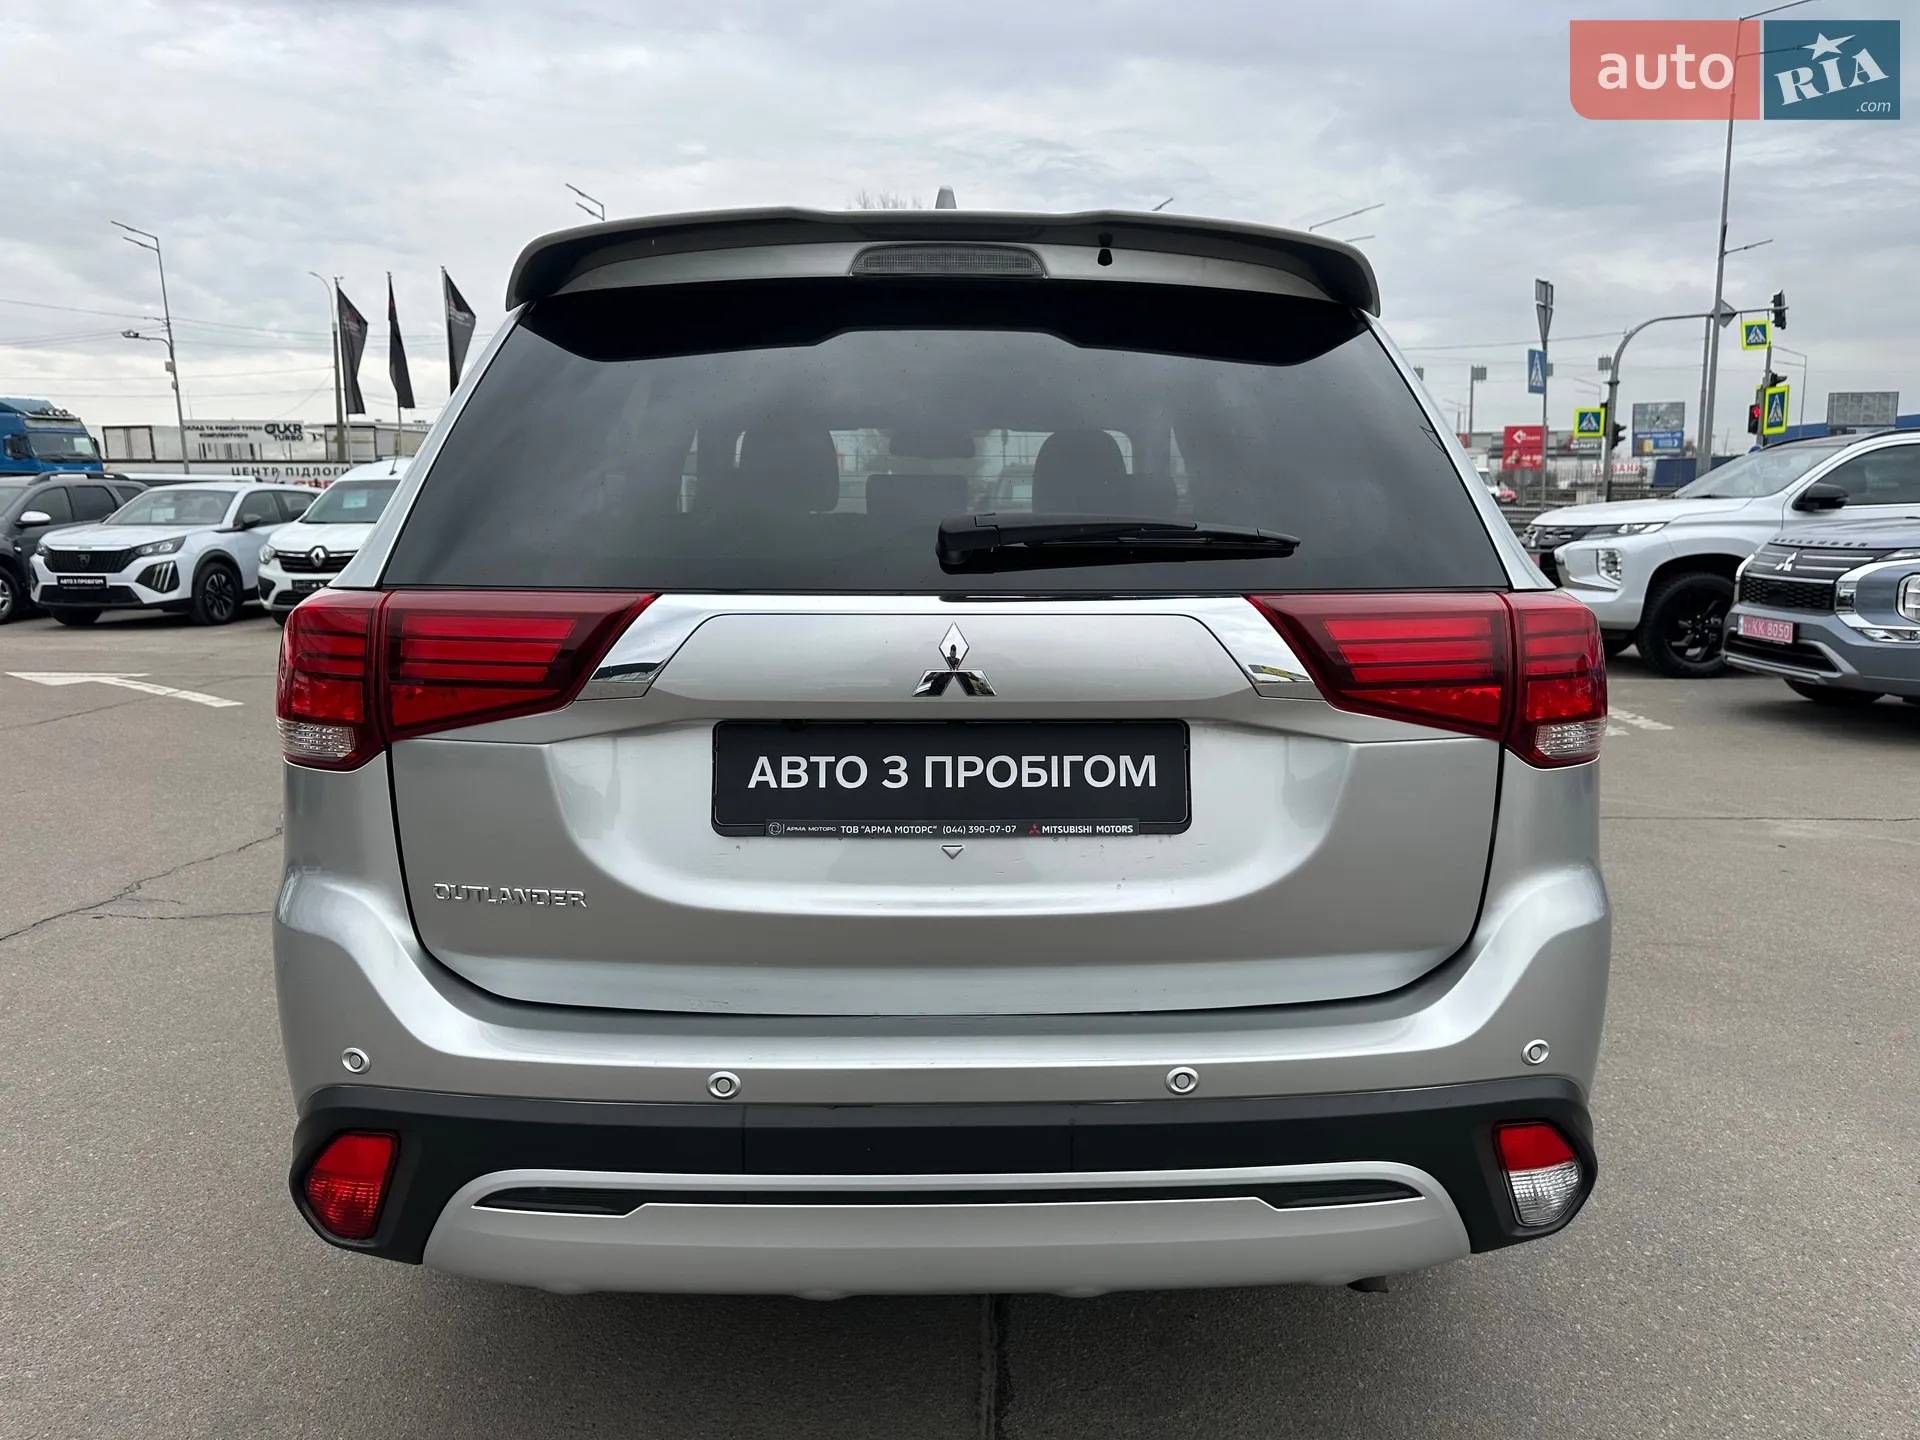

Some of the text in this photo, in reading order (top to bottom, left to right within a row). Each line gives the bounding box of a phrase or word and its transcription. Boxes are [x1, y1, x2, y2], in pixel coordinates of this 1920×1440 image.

[231, 467, 279, 476] ЦЕНТР
[1767, 622, 1790, 639] 8050
[747, 754, 1157, 790] АВТО З ПРОБІГОМ
[840, 825, 859, 834] ТОВ
[942, 825, 966, 835] (044)
[968, 825, 1017, 834] 390-07-07
[1042, 825, 1134, 834] MITSUBISHI MOTORS
[433, 883, 588, 908] OUTLANDER
